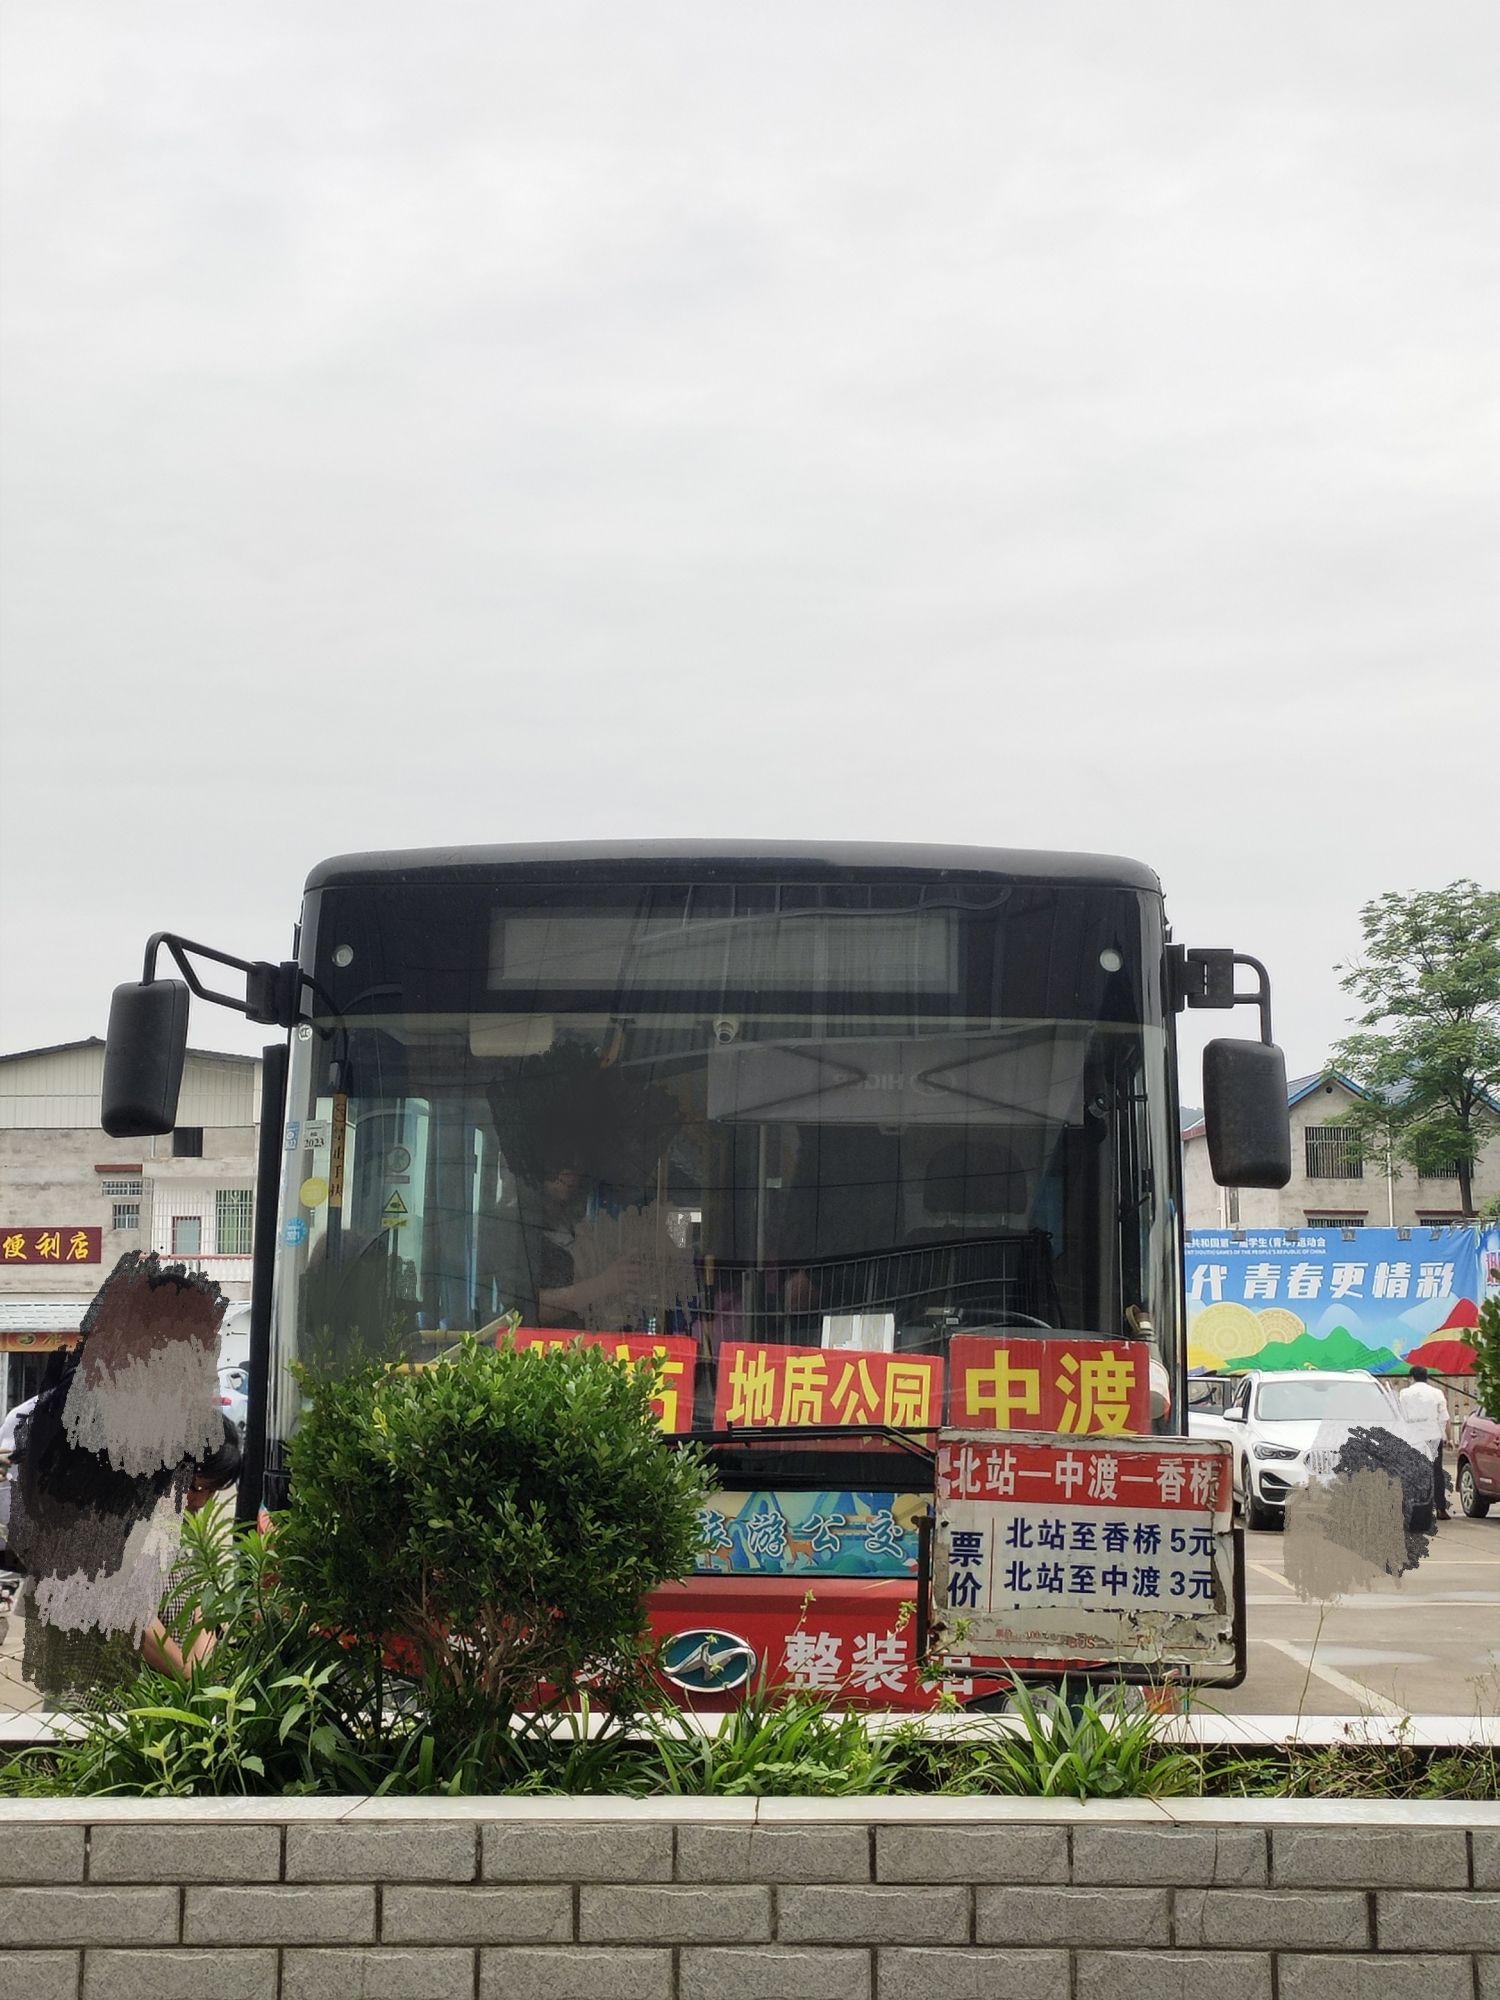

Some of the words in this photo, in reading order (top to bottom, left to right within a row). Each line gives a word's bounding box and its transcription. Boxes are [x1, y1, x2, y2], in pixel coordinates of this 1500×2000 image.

[2, 1231, 90, 1261] 便利店
[1192, 1264, 1228, 1300] 代
[1243, 1261, 1455, 1299] 青春更精彩
[725, 1349, 933, 1447] 地质公园
[965, 1350, 1138, 1435] 中渡
[698, 1509, 904, 1559] 旅游公交
[947, 1530, 984, 1608] 票价
